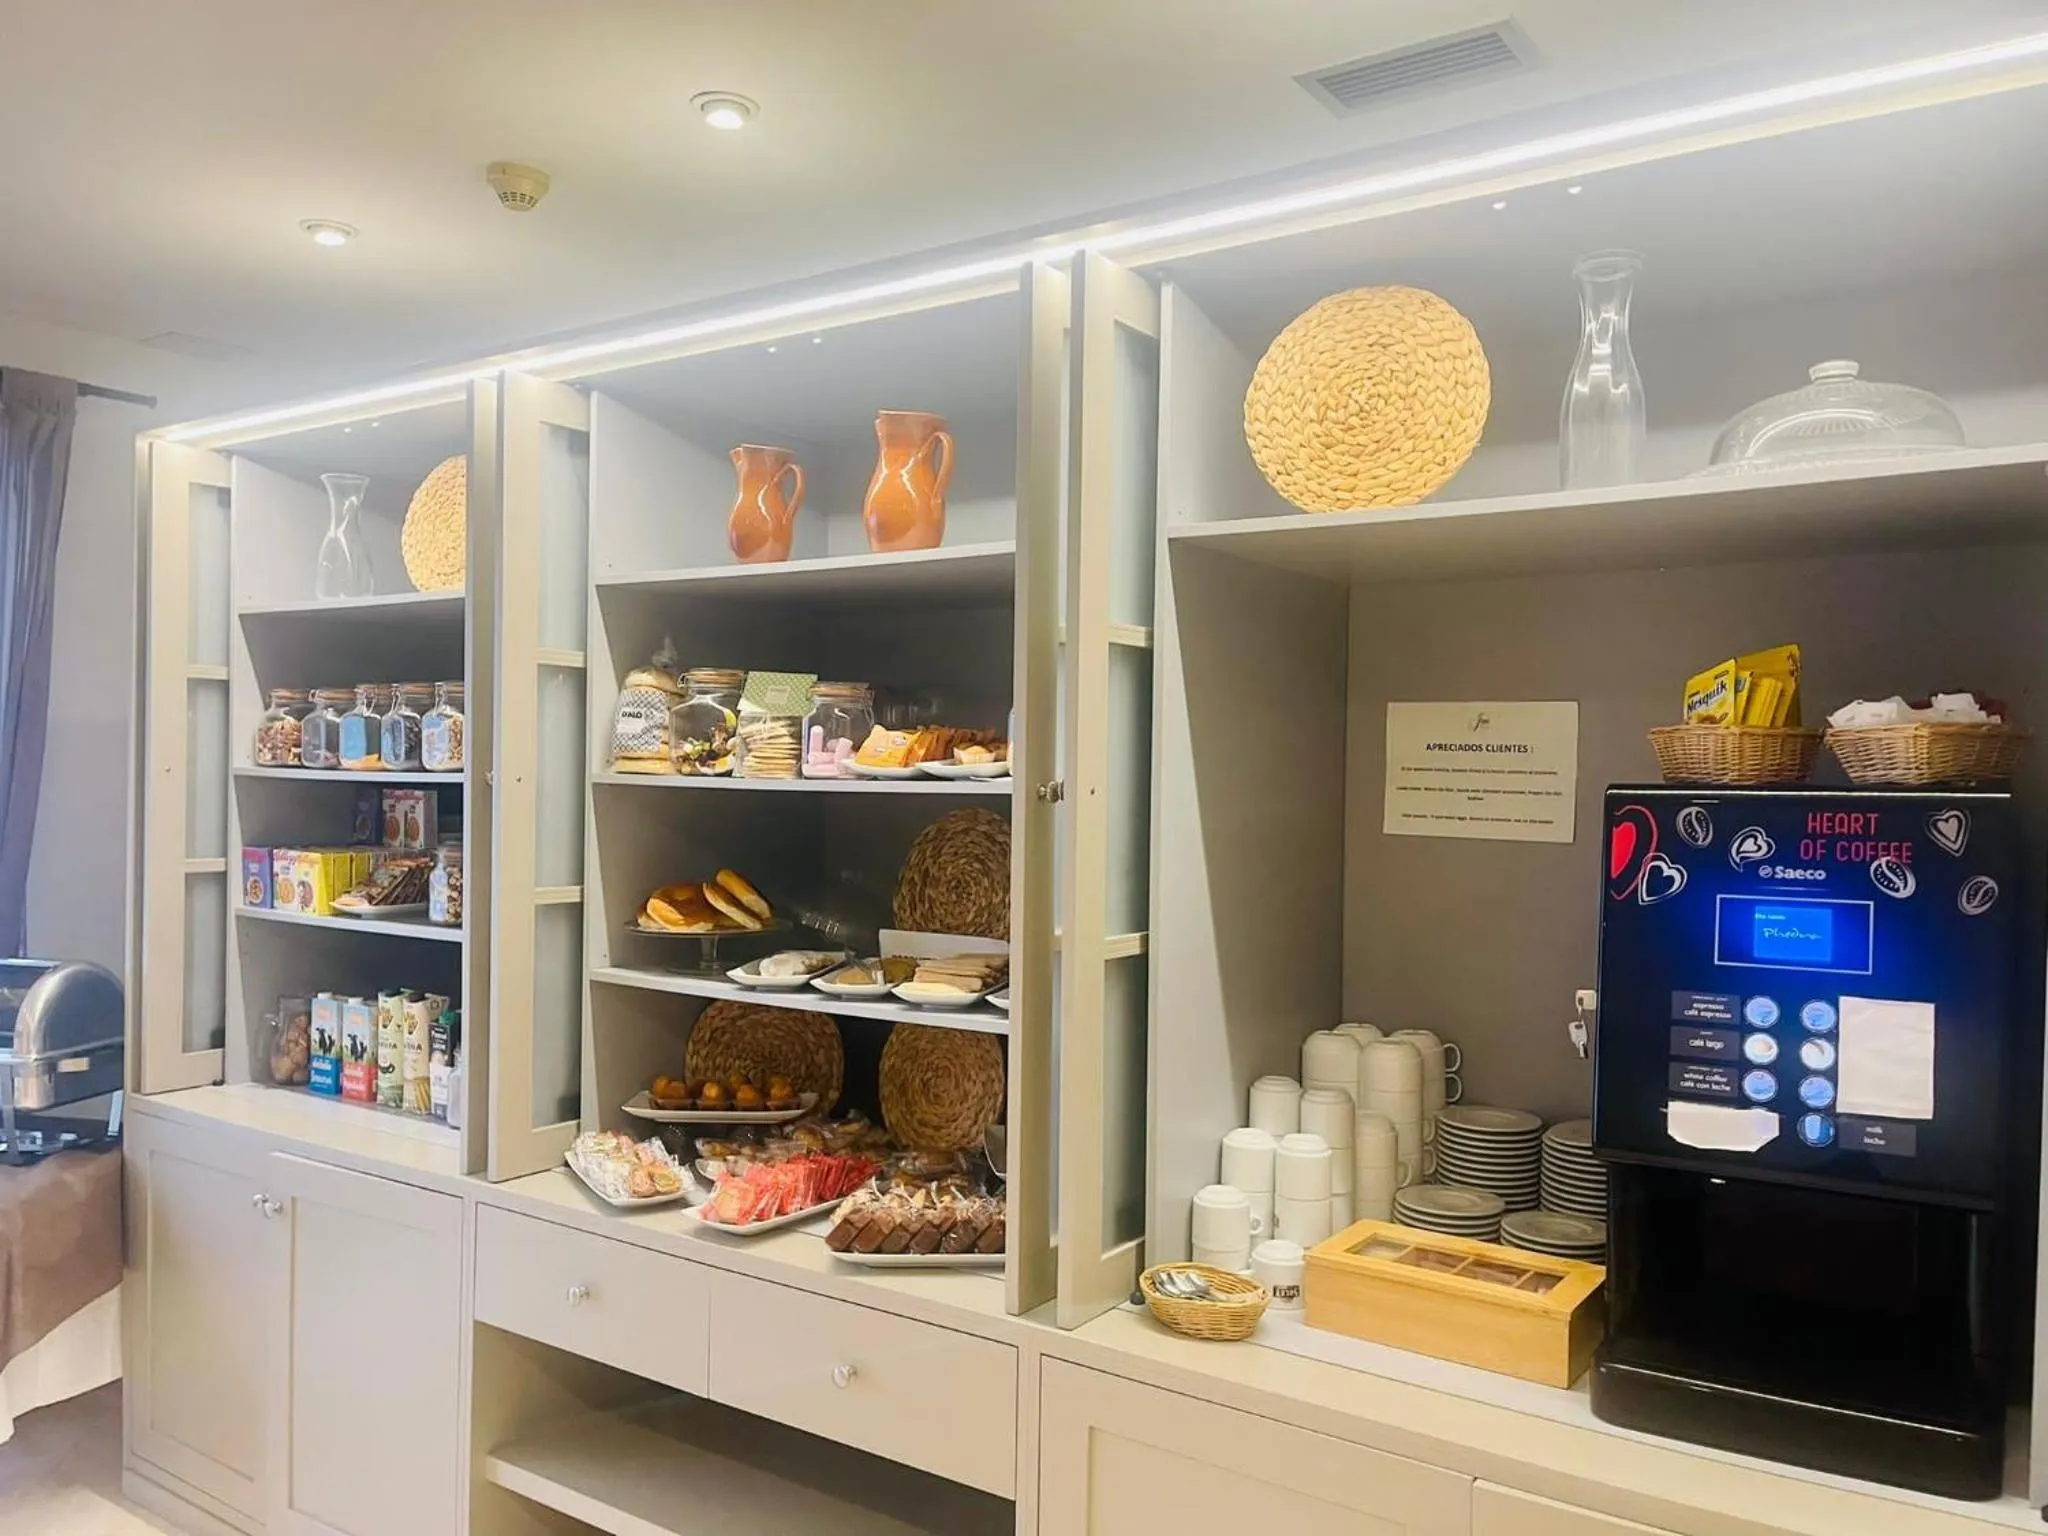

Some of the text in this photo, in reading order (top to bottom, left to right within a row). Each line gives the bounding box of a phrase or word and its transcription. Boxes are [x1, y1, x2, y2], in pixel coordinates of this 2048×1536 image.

[1687, 679, 1728, 712] Nesquik
[1426, 743, 1484, 752] APRECIADOS
[1485, 744, 1529, 753] CLIENTES
[1807, 812, 1879, 835] HEART
[1800, 839, 1912, 863] OF COFFEE
[1774, 865, 1827, 880] Saeco
